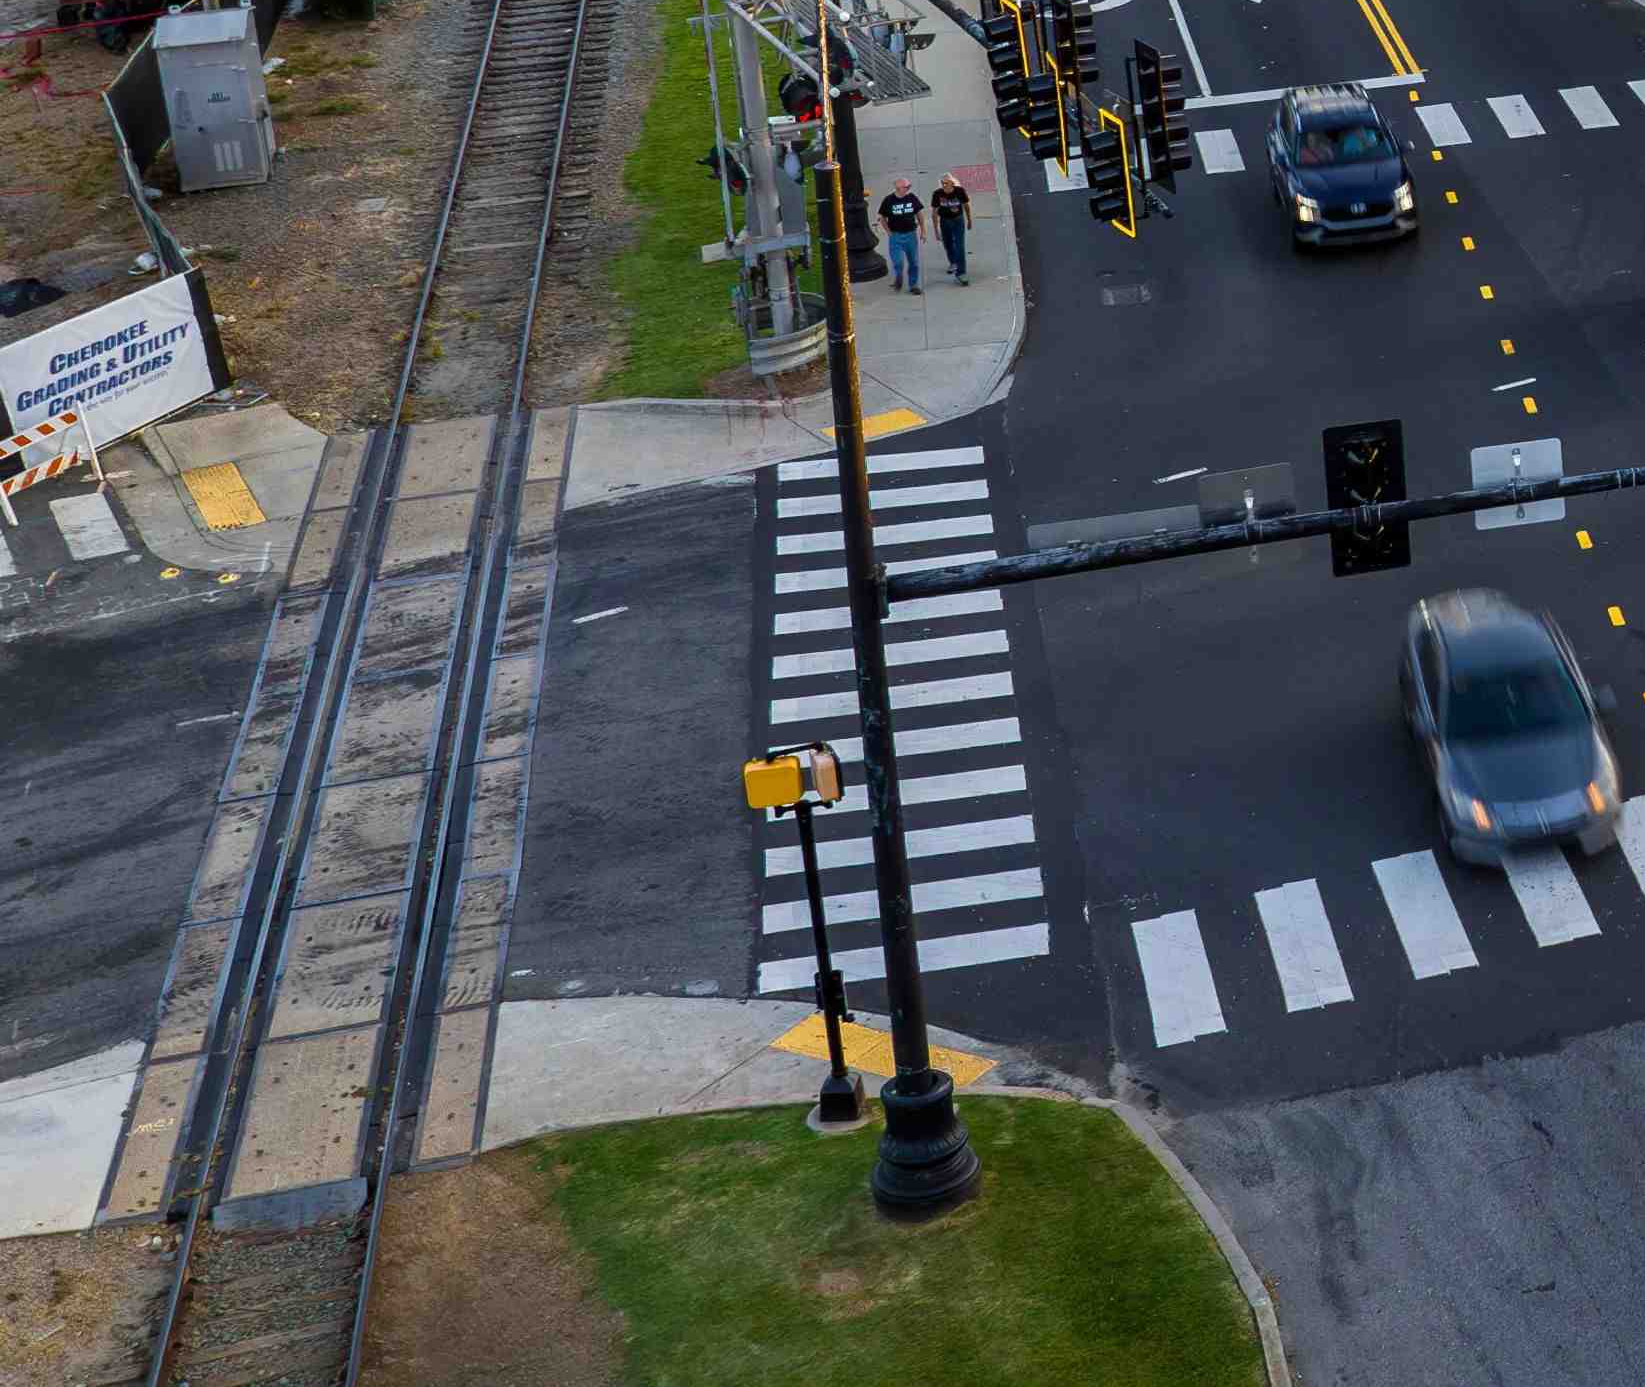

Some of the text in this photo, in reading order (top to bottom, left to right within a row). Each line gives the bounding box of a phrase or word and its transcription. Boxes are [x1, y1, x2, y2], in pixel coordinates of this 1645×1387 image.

[16, 362, 101, 412] GRADING
[105, 357, 118, 372] &
[122, 322, 189, 364] UTILITY
[49, 320, 150, 374] CHEROKEE
[48, 350, 174, 417] CONTRACTORS
